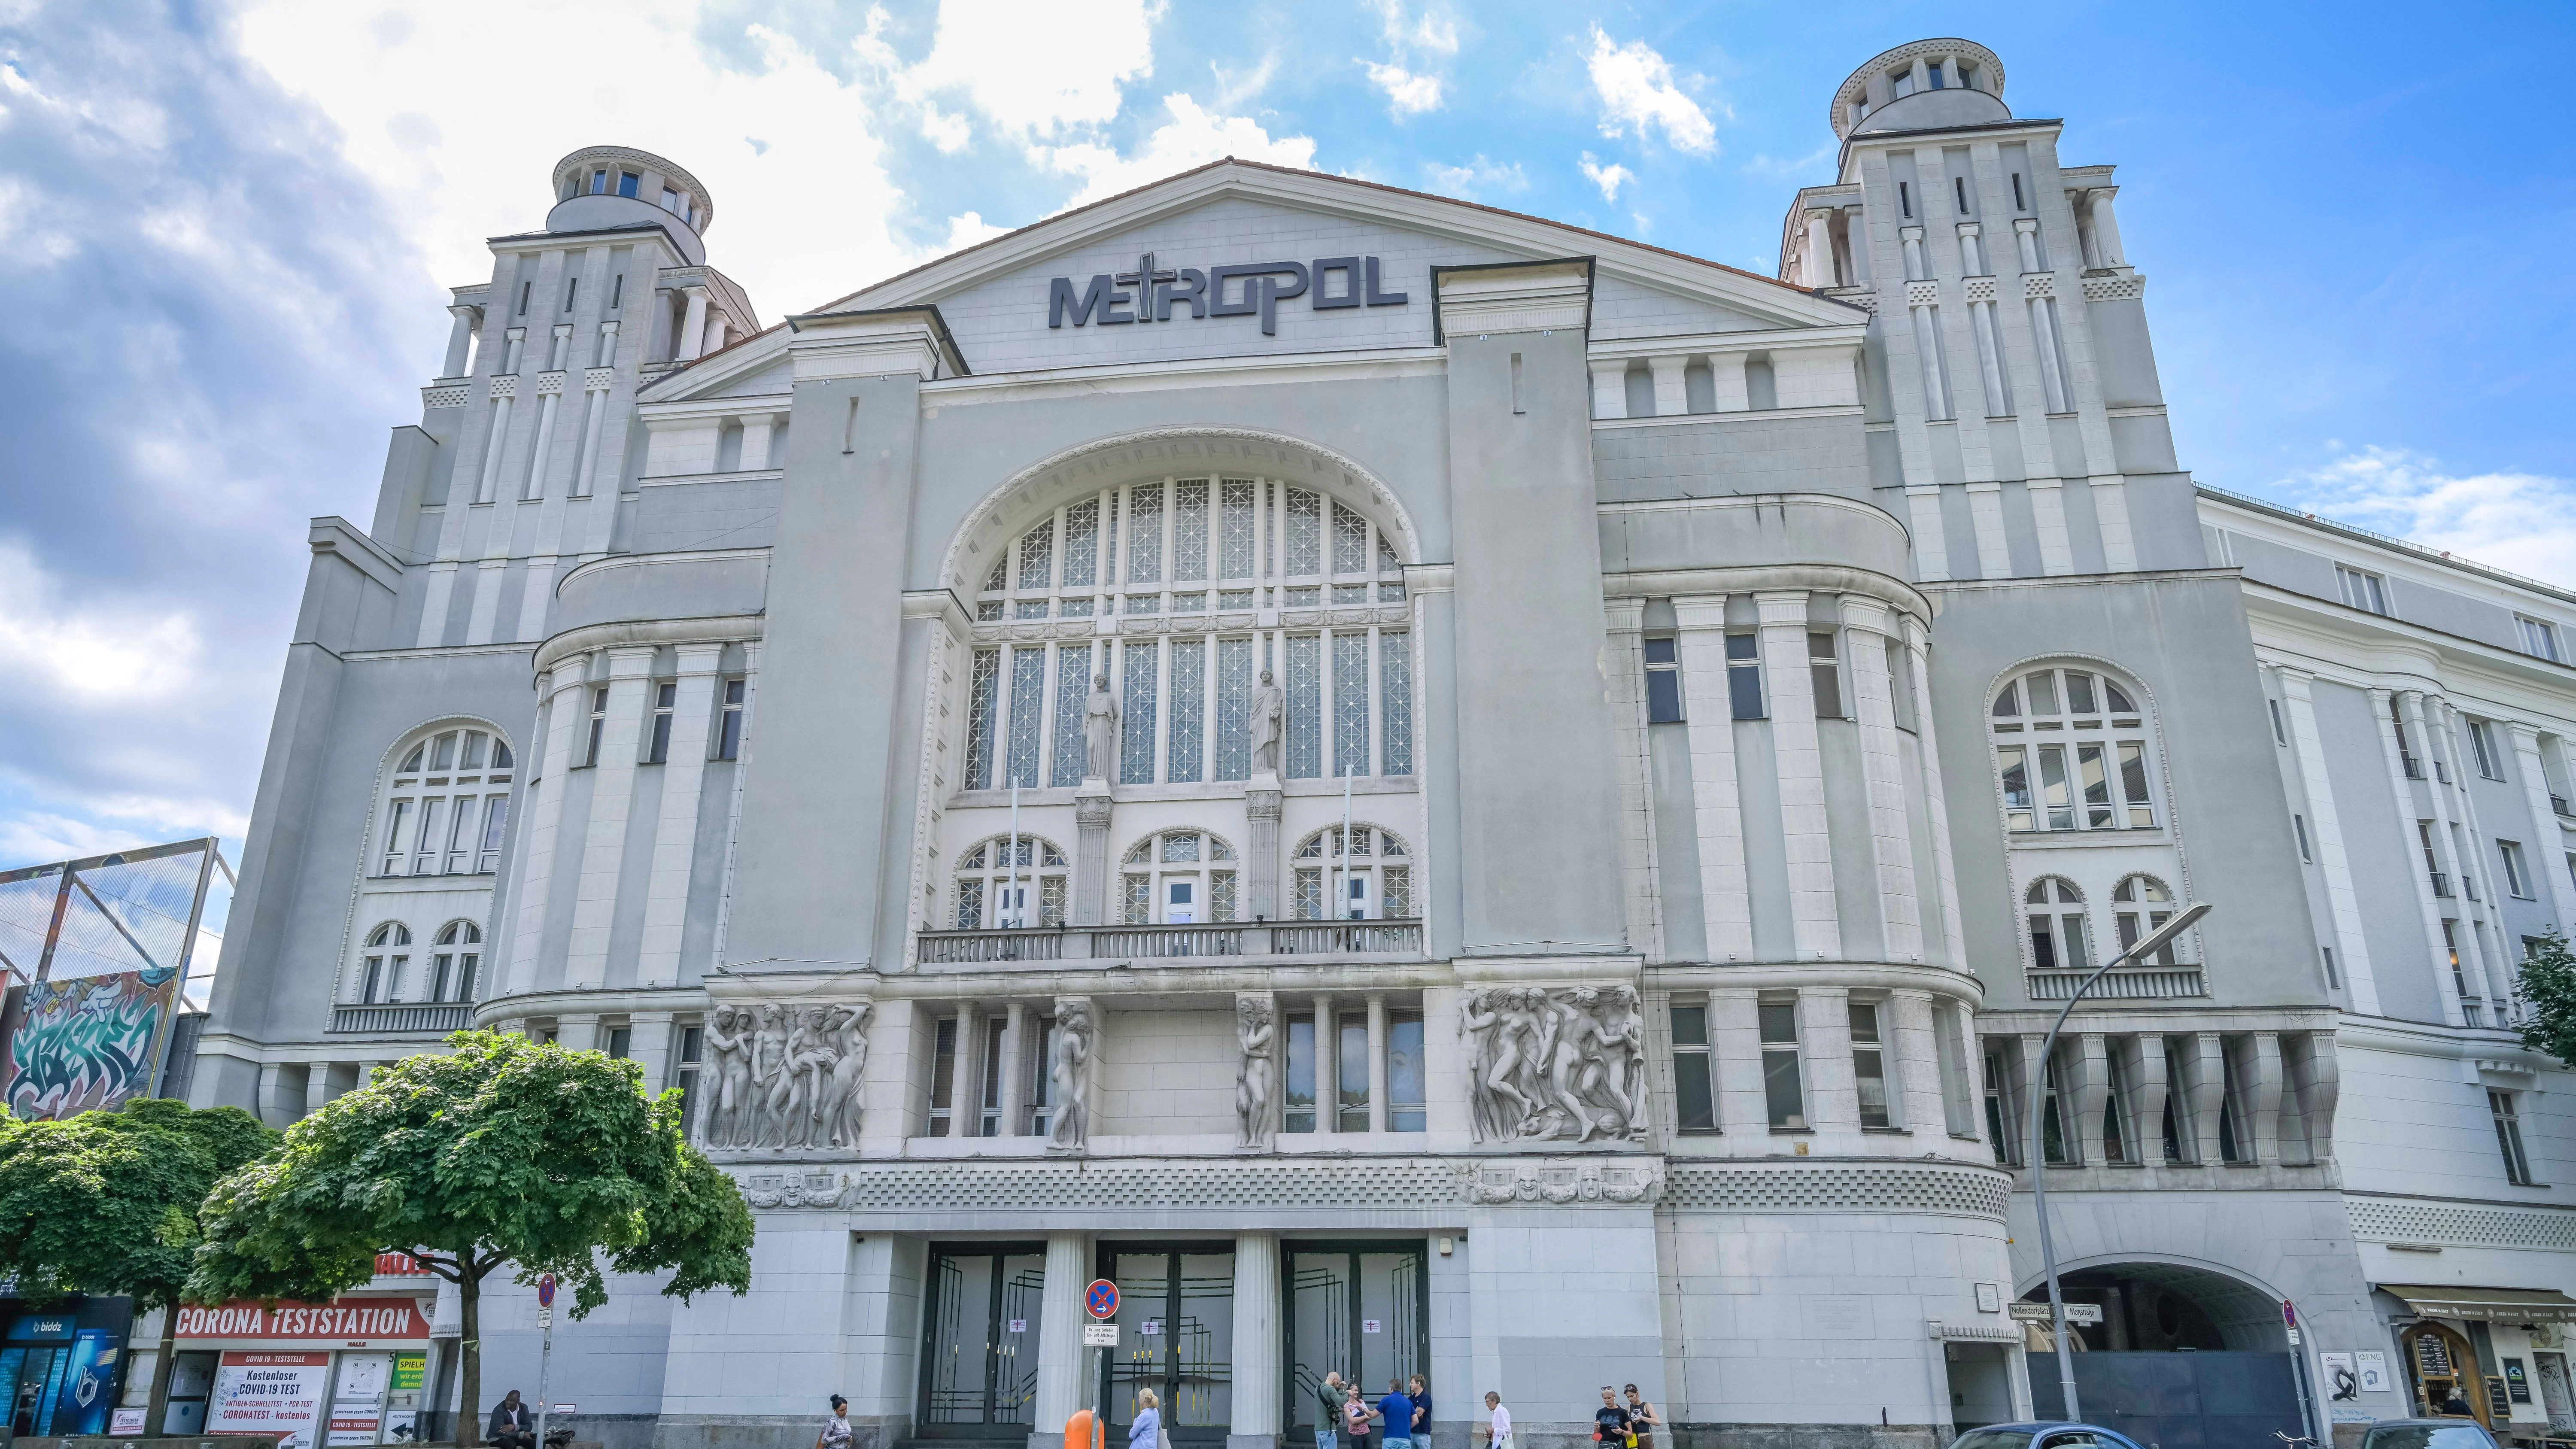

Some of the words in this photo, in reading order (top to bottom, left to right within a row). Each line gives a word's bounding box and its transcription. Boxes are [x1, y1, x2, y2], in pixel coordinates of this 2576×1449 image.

[1049, 252, 1408, 336] METROPOL
[2011, 1306, 2049, 1315] Nollendorfplatz
[2070, 1308, 2094, 1317] Motzstraße
[41, 1321, 62, 1331] biddz
[175, 1308, 261, 1334] CORONA
[271, 1308, 410, 1334] TESTSTATION
[389, 1352, 395, 1362] 5
[247, 1370, 298, 1381] Kostenloser
[239, 1384, 278, 1395] COVID-19
[280, 1384, 300, 1395] TEST
[223, 1410, 270, 1419] CORONATEST
[276, 1411, 310, 1420] kostenlos
